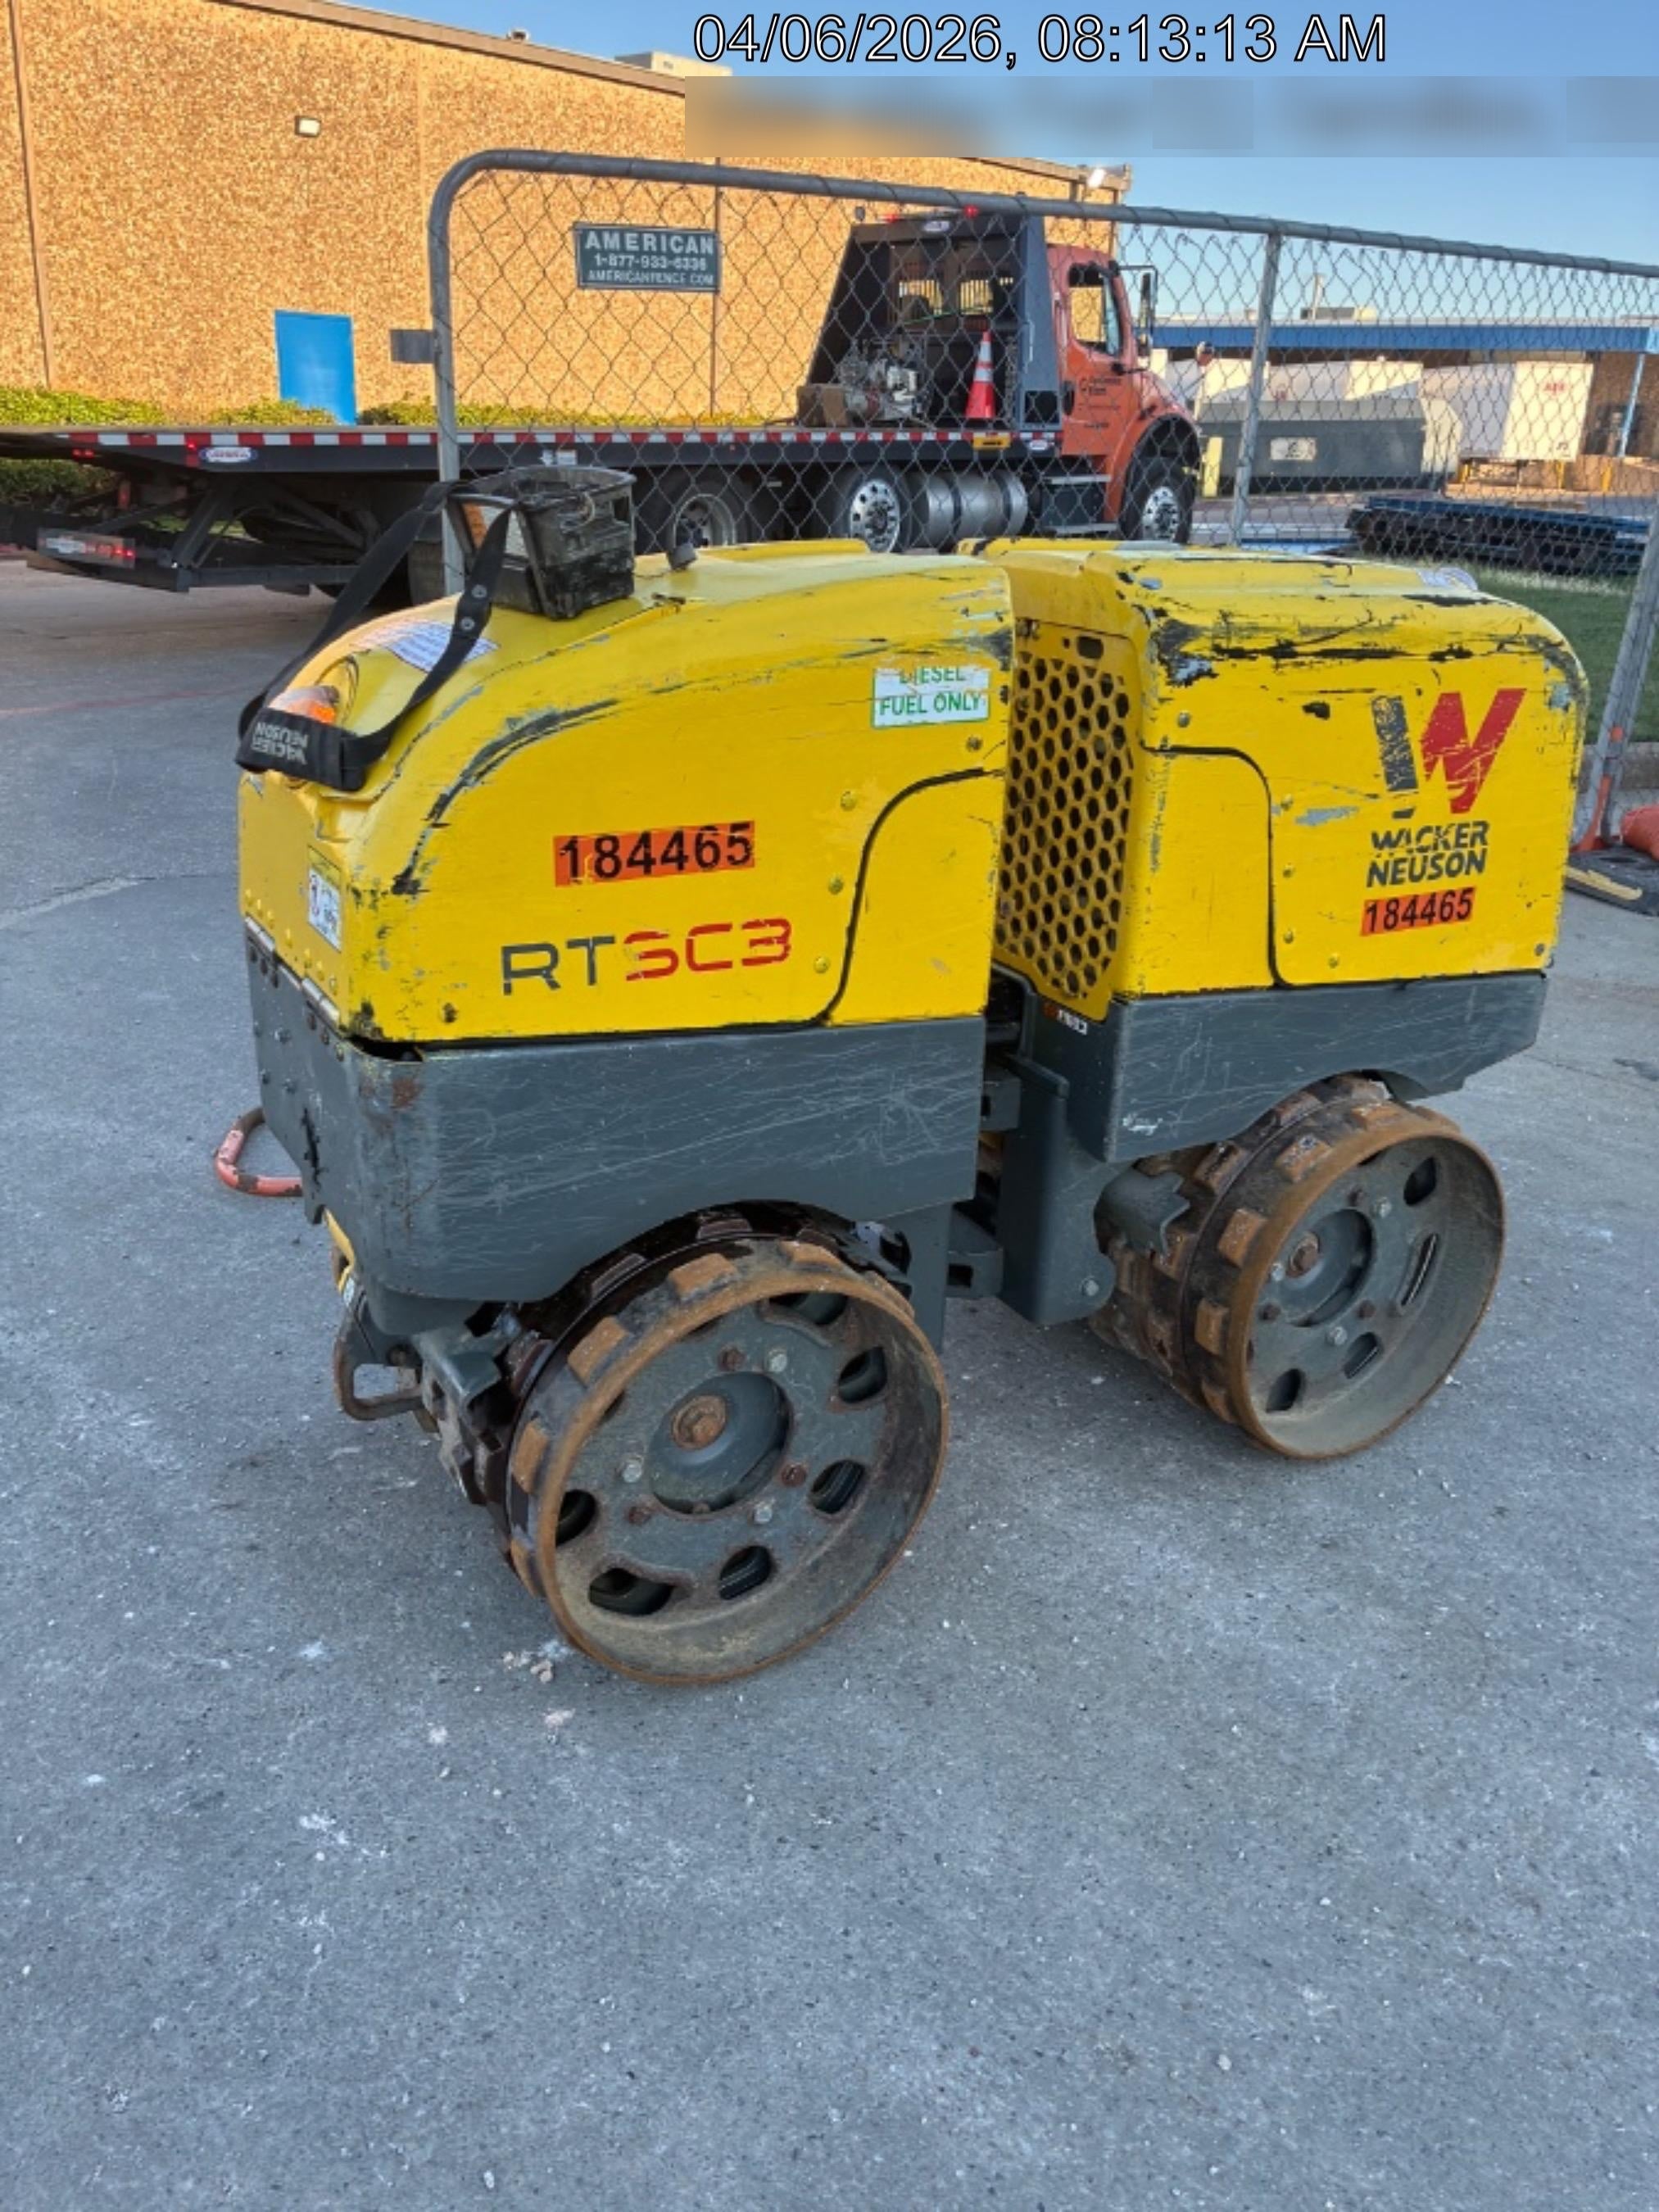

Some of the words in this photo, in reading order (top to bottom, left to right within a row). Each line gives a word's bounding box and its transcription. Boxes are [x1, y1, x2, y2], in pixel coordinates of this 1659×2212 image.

[585, 230, 714, 255] AMERICAN
[879, 695, 927, 715] FUEL
[933, 691, 981, 713] ONLY
[559, 822, 753, 885] 184465
[1366, 847, 1488, 887] NEUSON
[1365, 887, 1474, 932] 184465
